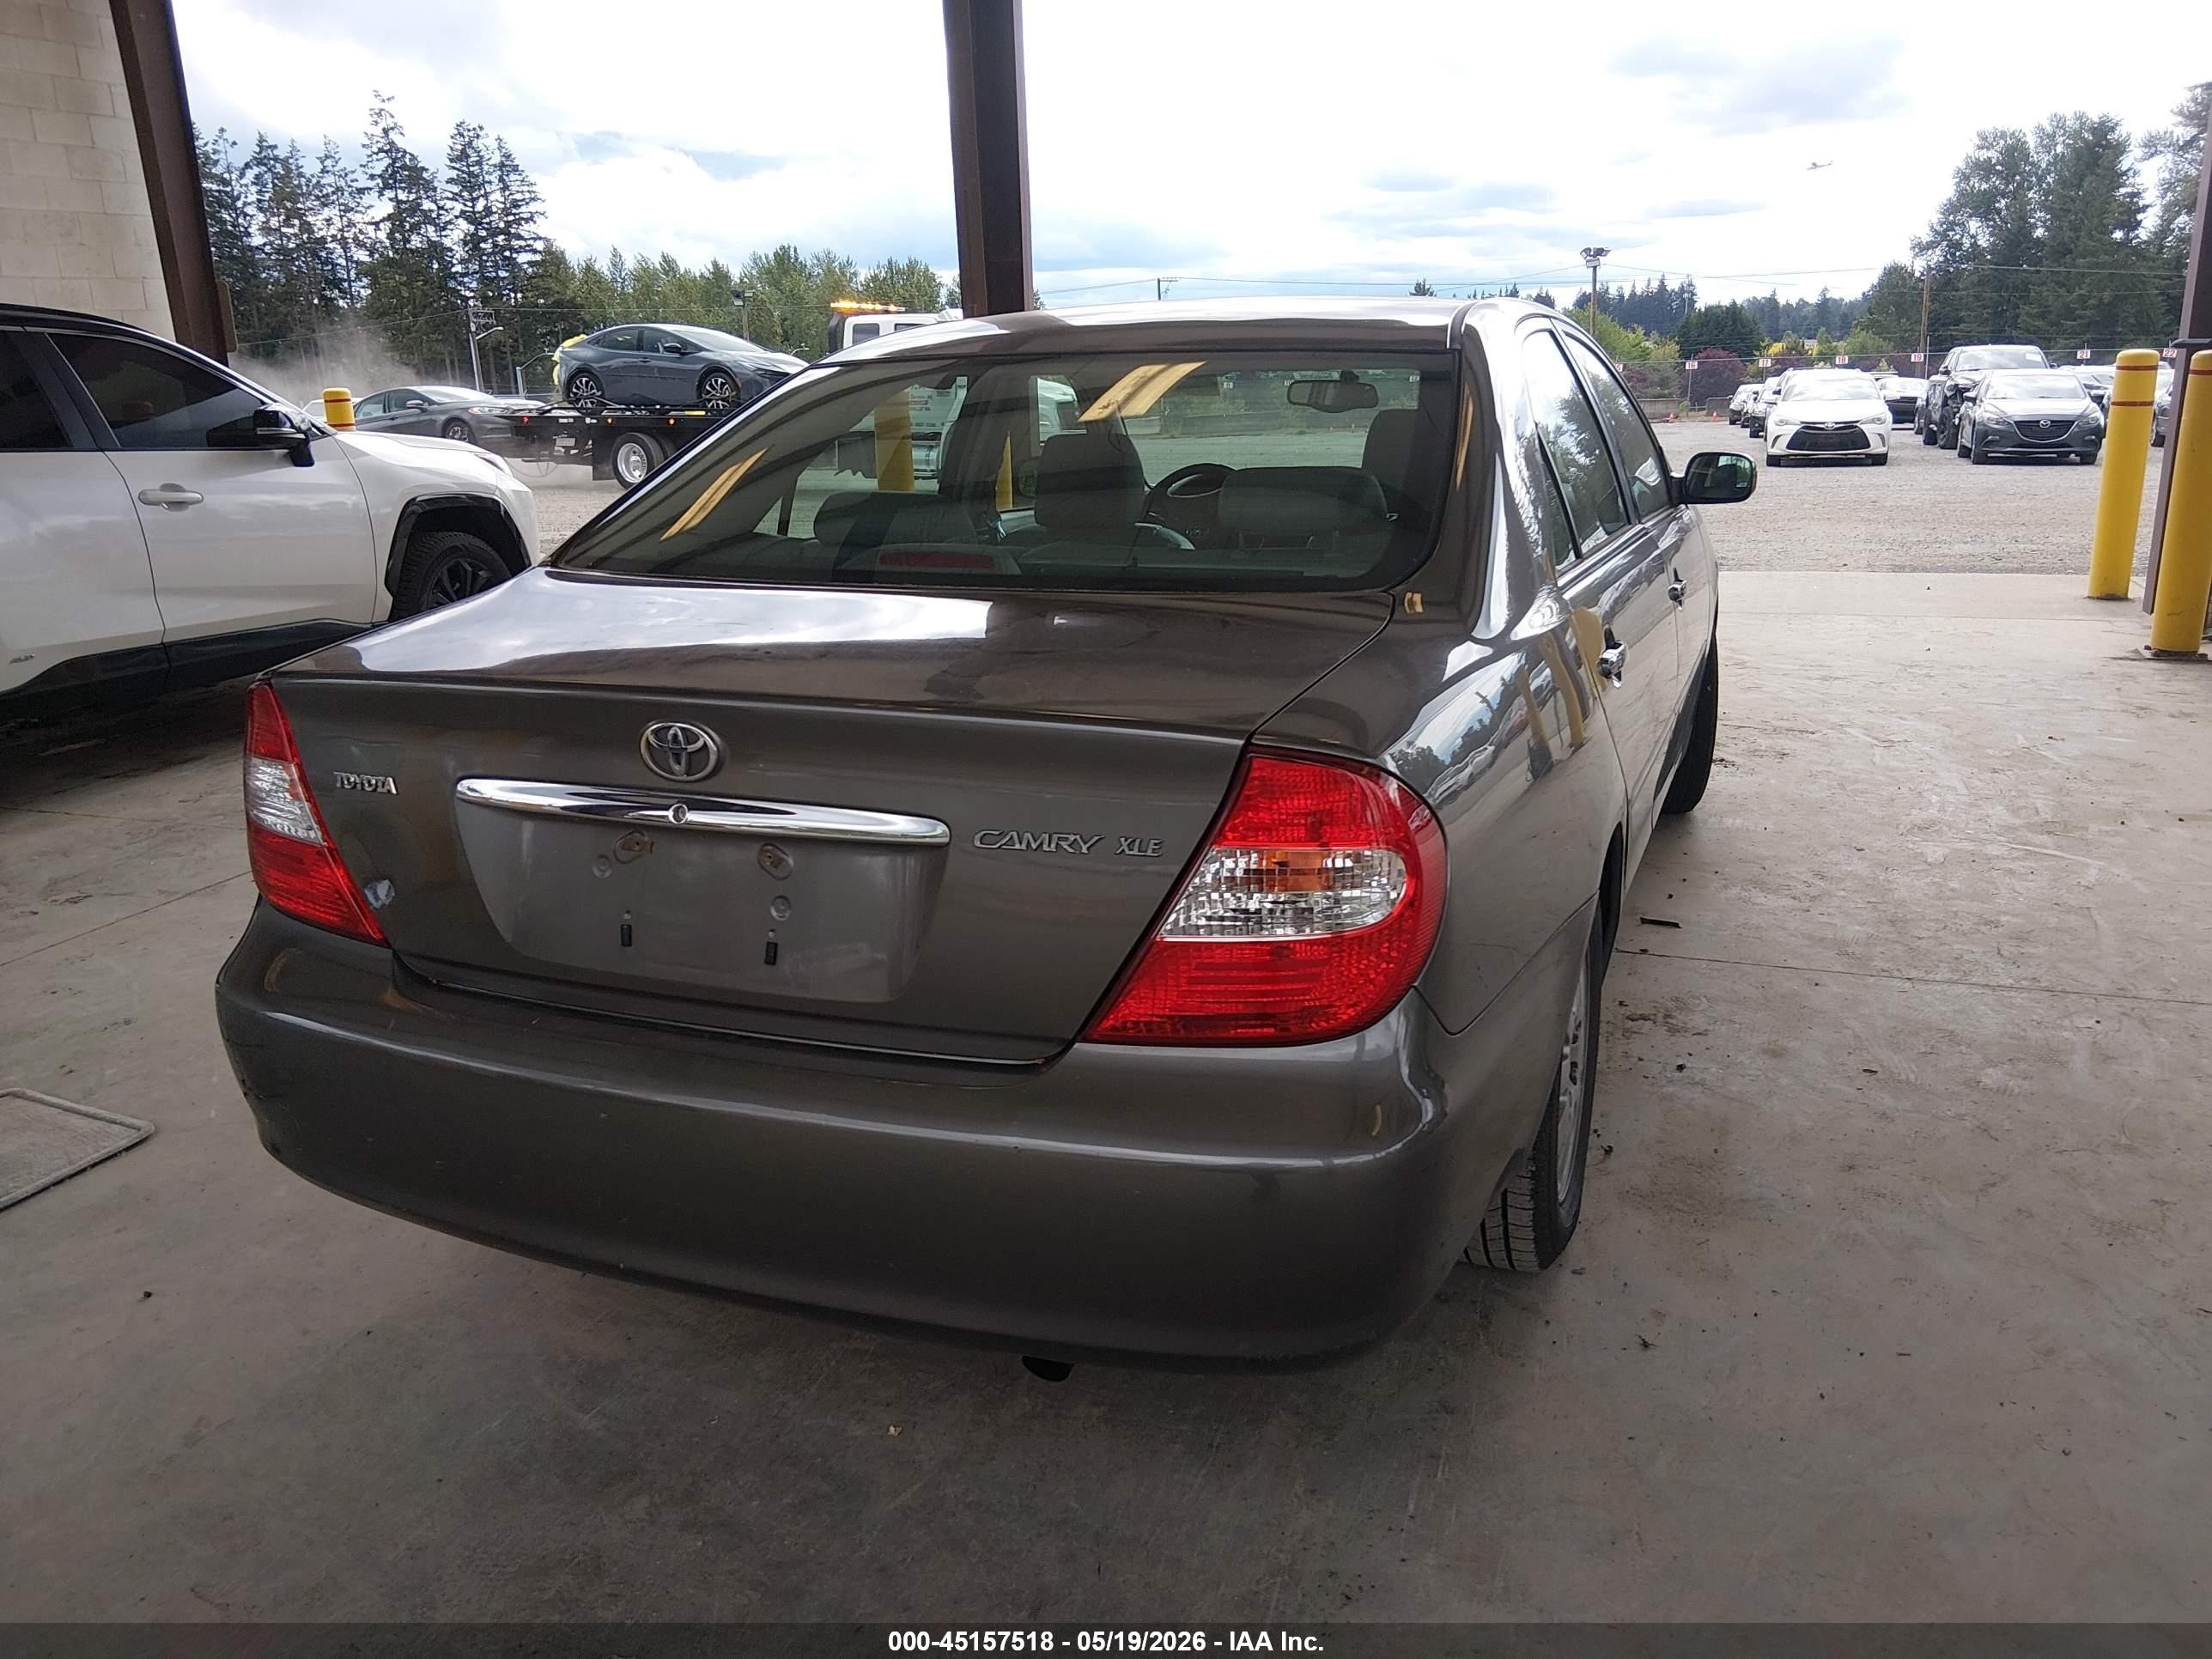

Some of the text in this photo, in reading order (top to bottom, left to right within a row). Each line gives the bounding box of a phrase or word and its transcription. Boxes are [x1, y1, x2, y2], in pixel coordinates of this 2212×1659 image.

[332, 771, 398, 794] TOYOTA
[974, 830, 1164, 857] CAMRY XLE
